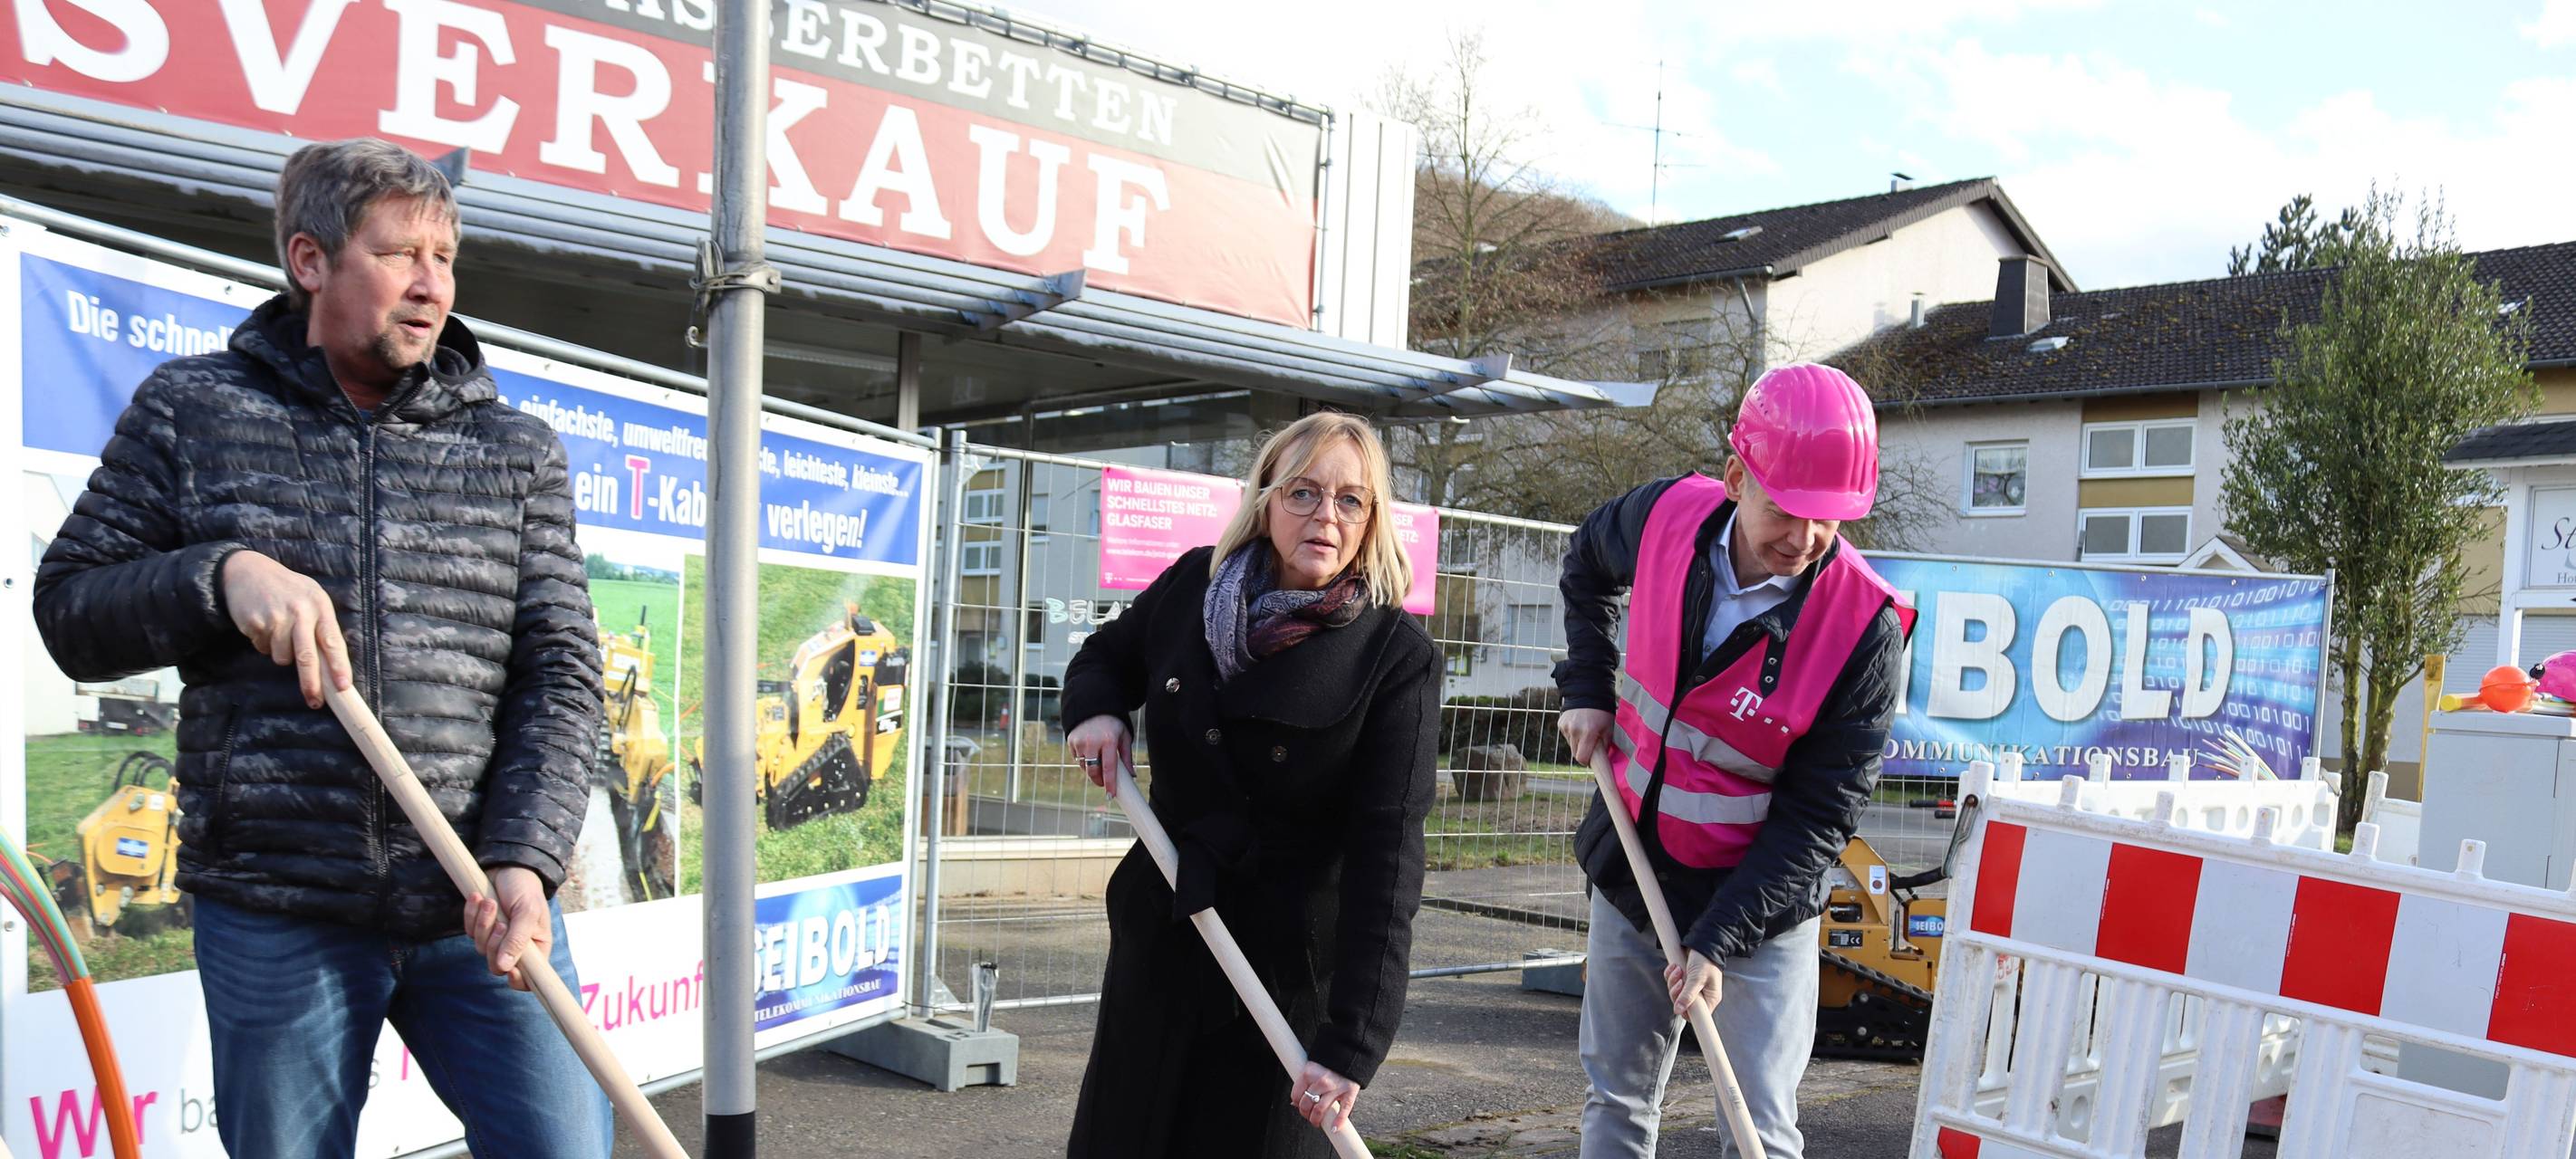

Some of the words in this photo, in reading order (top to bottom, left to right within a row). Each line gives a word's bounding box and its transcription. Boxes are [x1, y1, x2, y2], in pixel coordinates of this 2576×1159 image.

[67, 290, 120, 342] Die
[128, 313, 230, 357] schnel
[783, 449, 850, 492] leichteste,
[1107, 477, 1131, 493] WIR
[1134, 481, 1172, 497] BAUEN
[1174, 484, 1210, 499] UNSER
[574, 463, 619, 514] ein
[625, 454, 707, 527] T-Kab
[767, 499, 868, 554] verlegen!
[1107, 495, 1185, 515] SCHNELLSTES
[1187, 504, 1217, 518] NETZ:
[1107, 512, 1172, 530] GLASFASER
[1045, 598, 1132, 625] BELA
[1883, 738, 2200, 769] OMMUNIKATIONSBAU
[581, 959, 705, 1031] Zukunf
[30, 1087, 159, 1159] Wr
